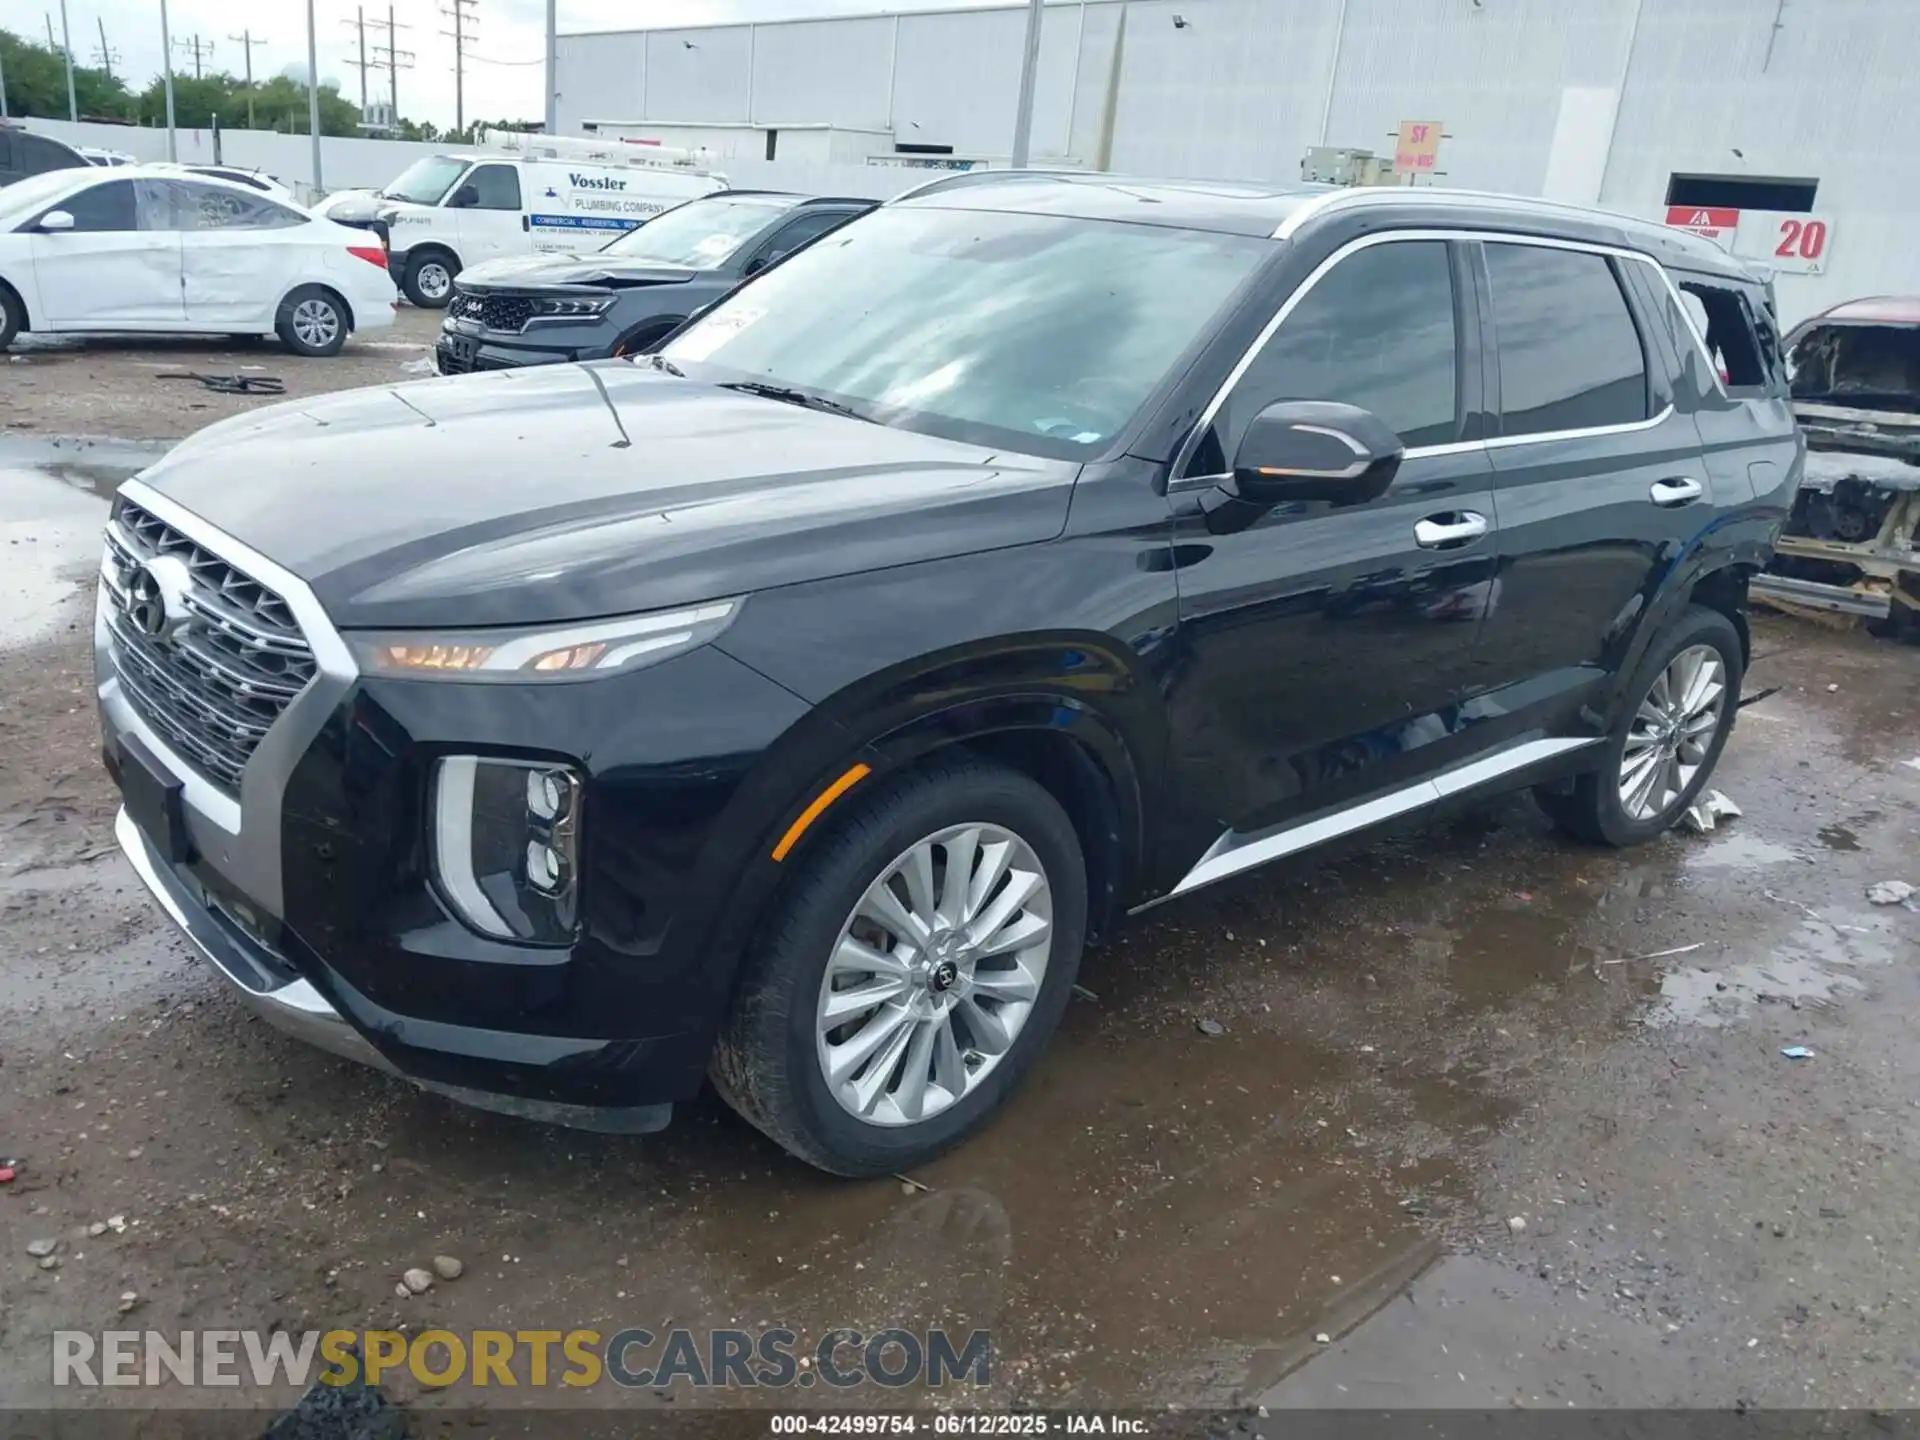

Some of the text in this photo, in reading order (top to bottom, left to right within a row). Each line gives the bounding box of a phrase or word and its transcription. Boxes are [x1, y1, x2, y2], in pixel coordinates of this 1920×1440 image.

[569, 173, 627, 191] Vossler
[575, 199, 665, 213] PLUMBING COMPANY
[1775, 219, 1826, 259] 20
